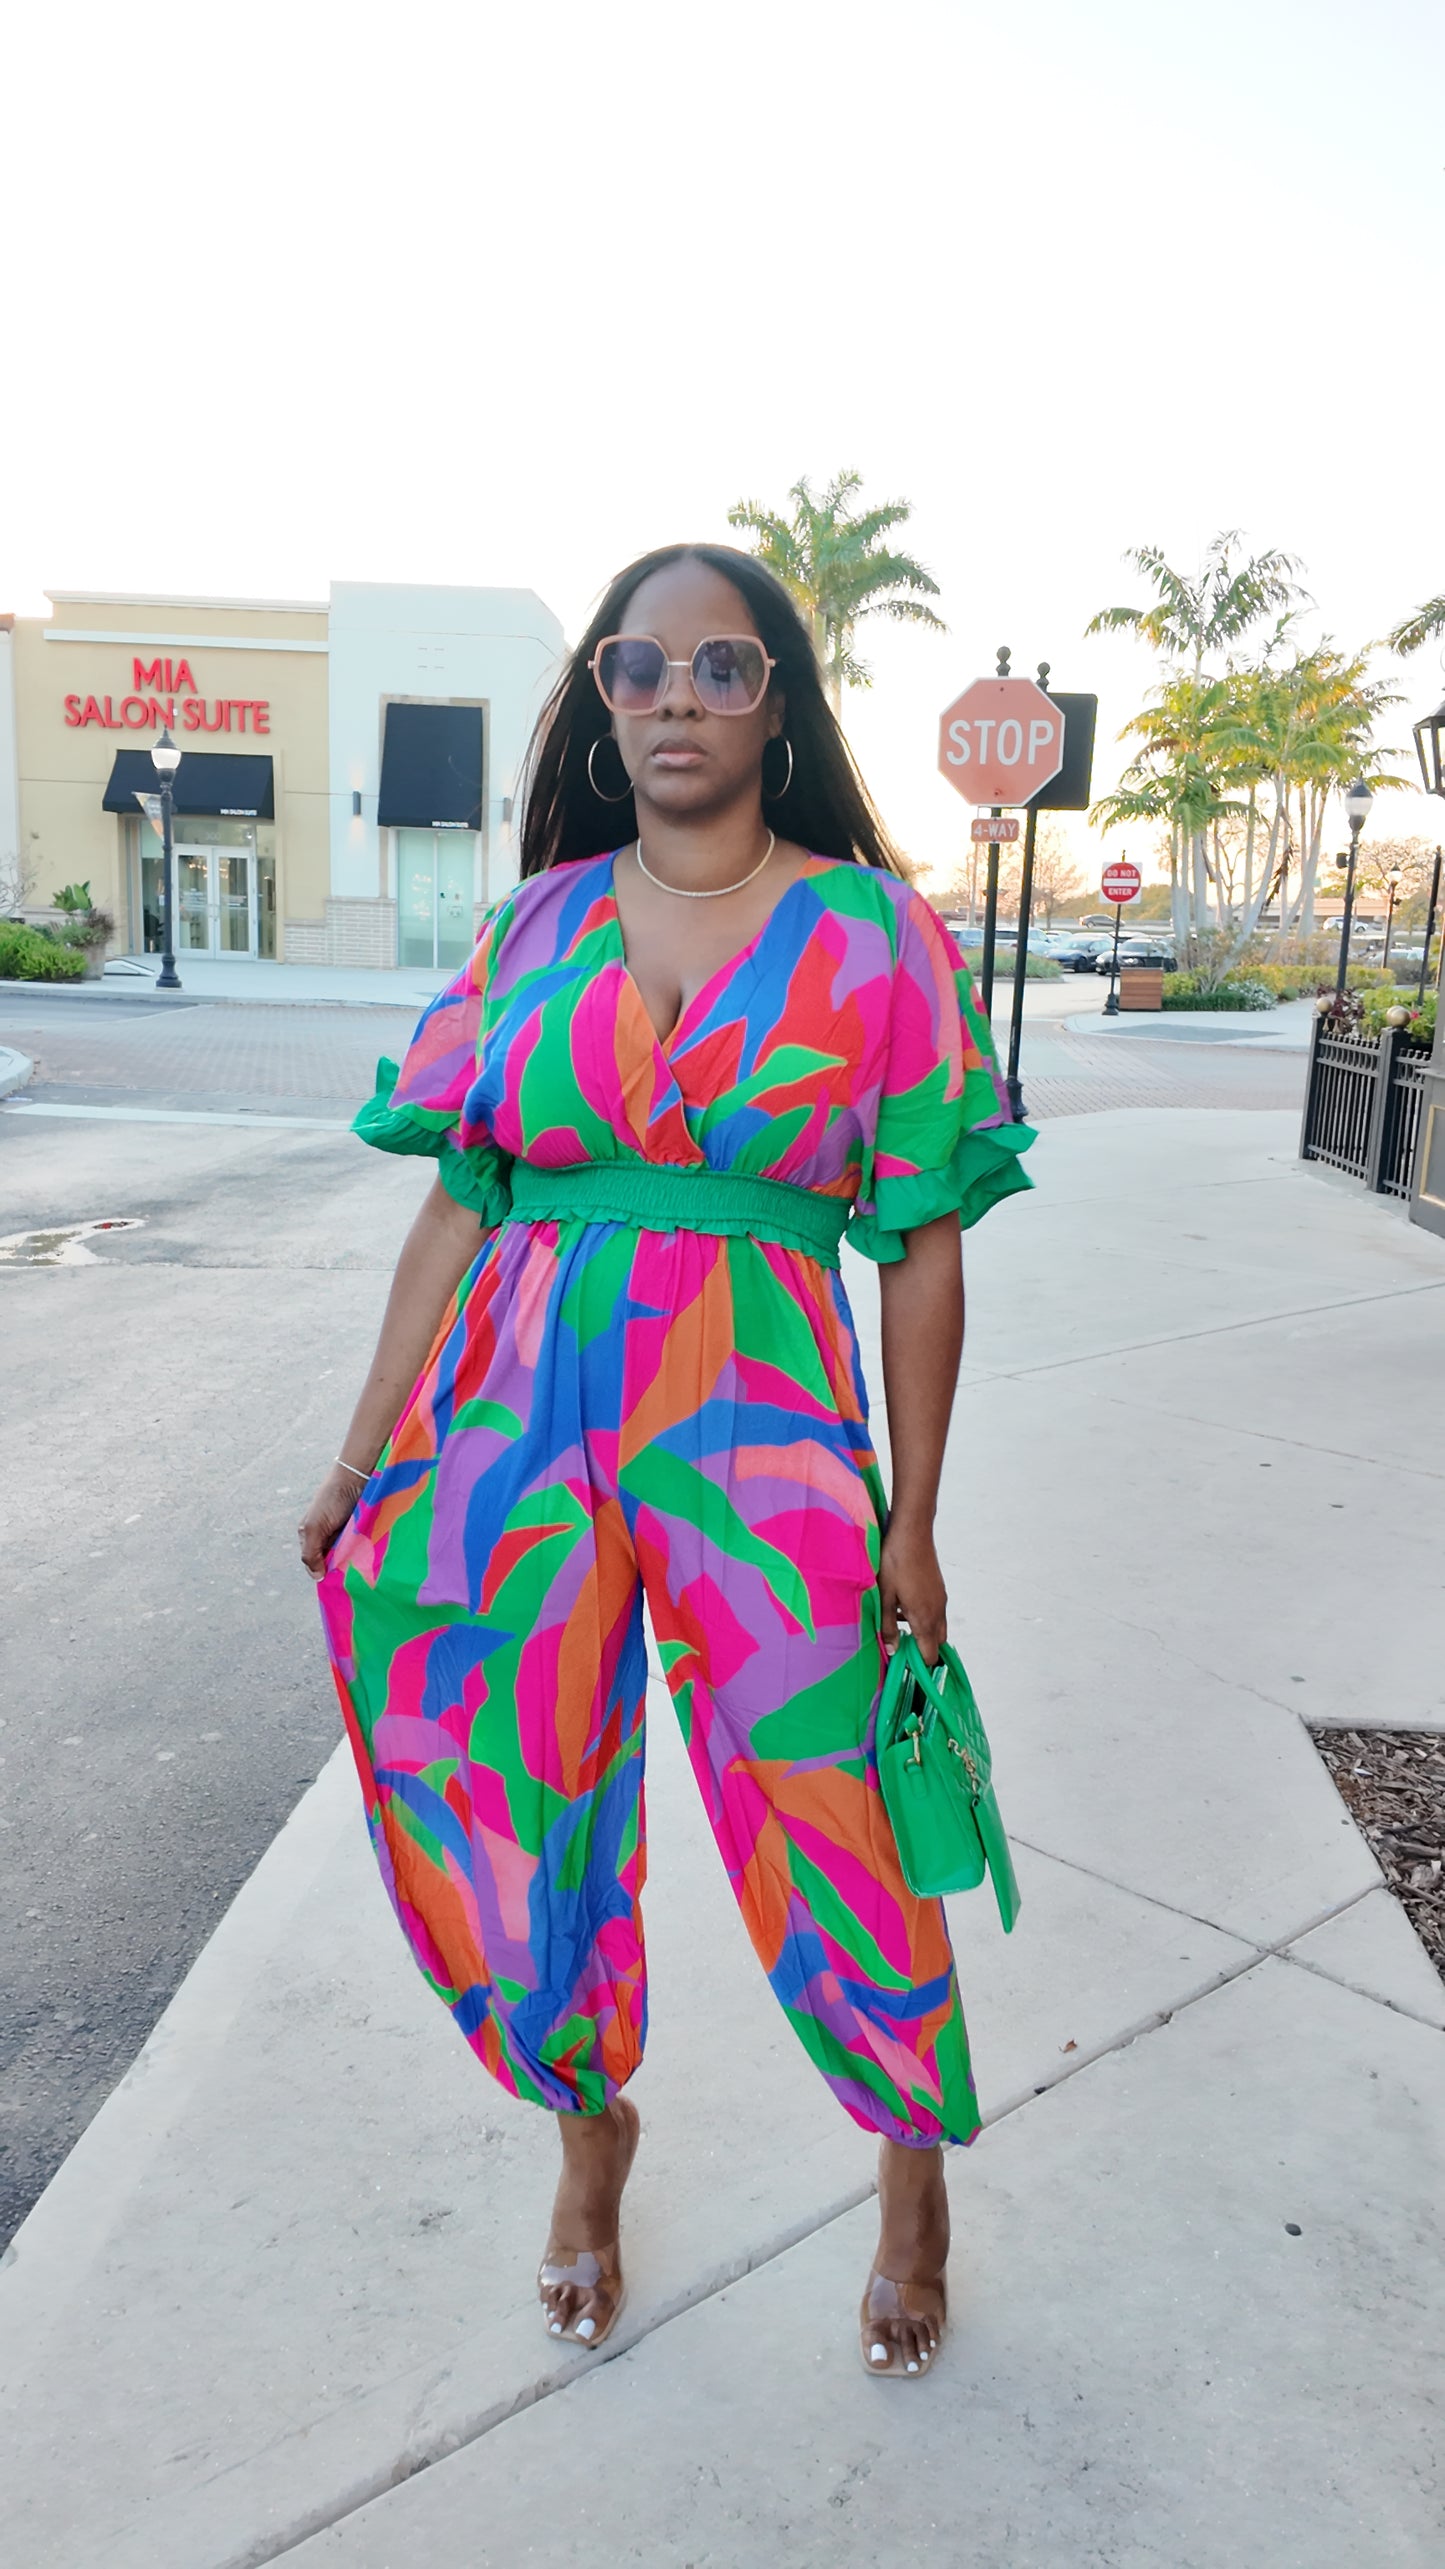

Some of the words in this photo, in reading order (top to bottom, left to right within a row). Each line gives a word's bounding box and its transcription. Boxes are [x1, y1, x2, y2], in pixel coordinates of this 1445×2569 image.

[133, 657, 198, 693] MIA
[64, 694, 174, 730] SALON
[182, 698, 270, 734] SUITE
[946, 719, 1054, 766] STOP
[973, 823, 1016, 838] 4-WAY
[1106, 869, 1118, 878] DO
[1120, 869, 1137, 878] NOT
[1108, 887, 1133, 896] ENTER
